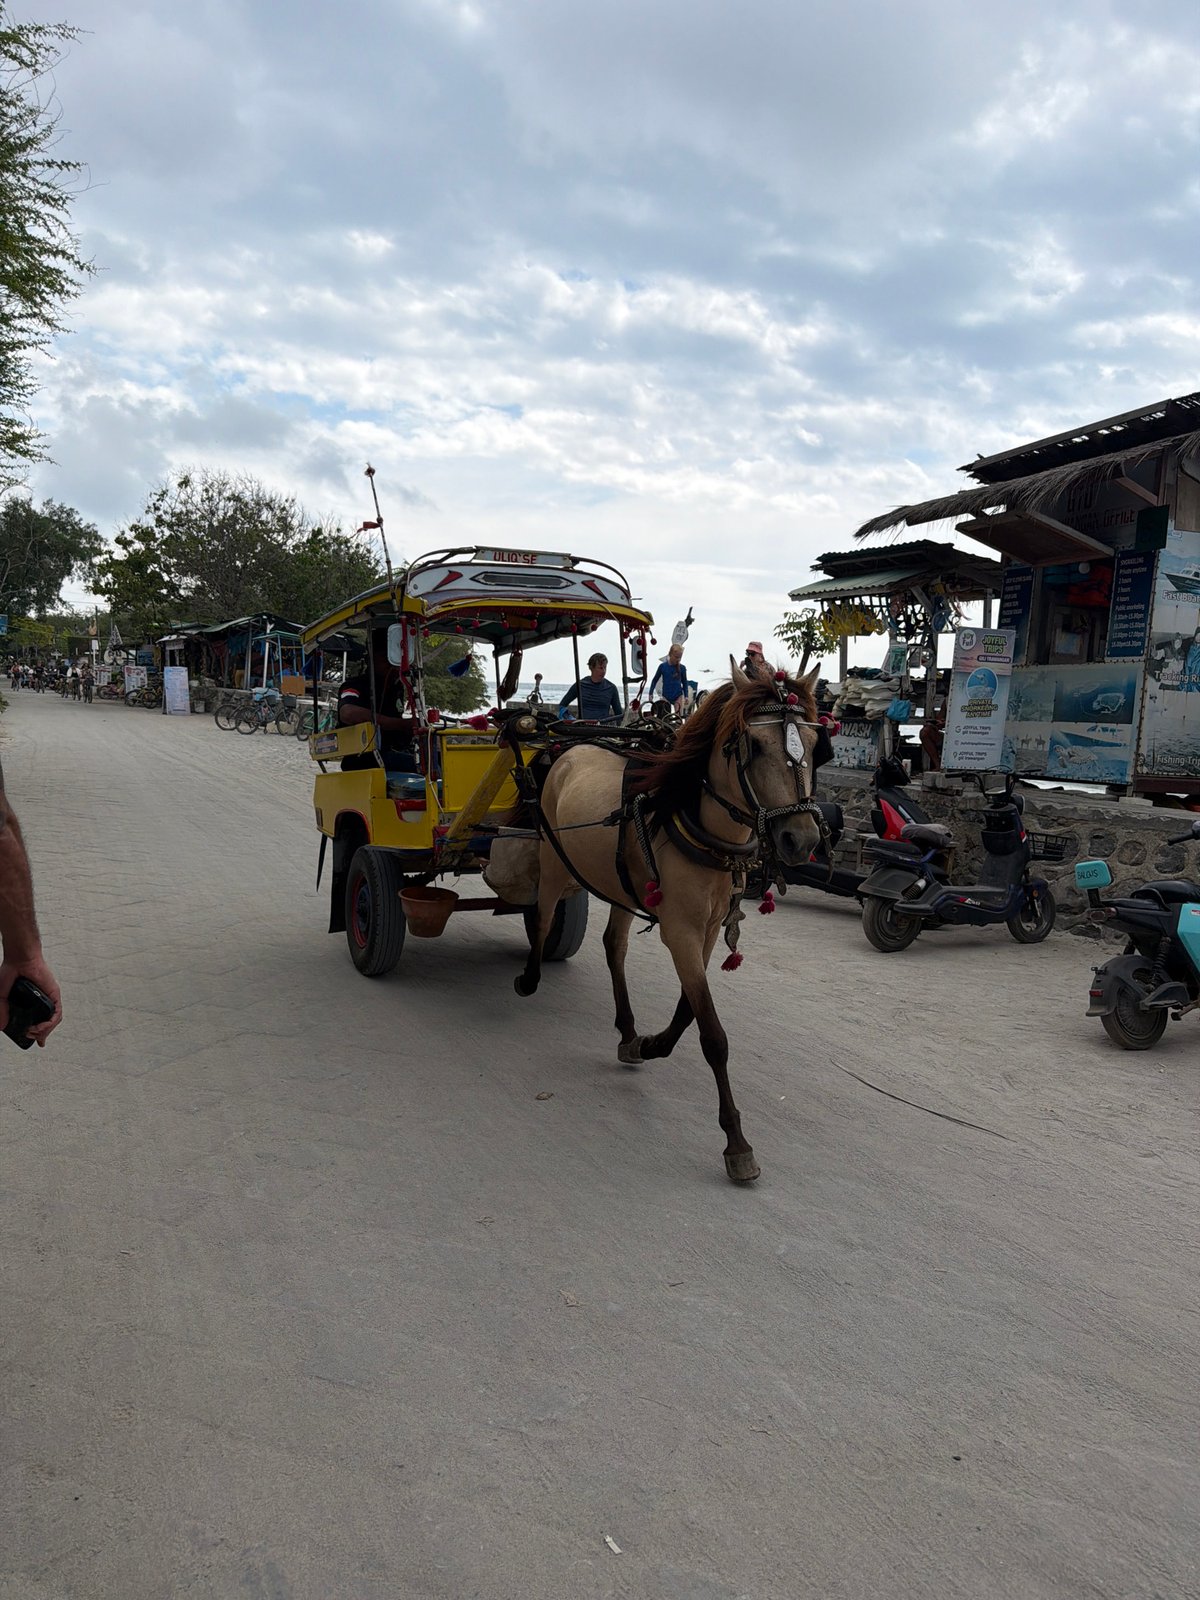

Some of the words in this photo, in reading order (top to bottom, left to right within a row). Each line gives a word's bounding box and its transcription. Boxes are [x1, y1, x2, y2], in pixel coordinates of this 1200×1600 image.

[1103, 509, 1135, 528] OFFICE
[1162, 590, 1180, 601] Fast
[982, 634, 1007, 646] JOYFUL
[984, 644, 1004, 654] TRIPS
[1154, 670, 1189, 683] Tracking
[1191, 674, 1200, 683] Ri
[967, 698, 992, 706] PRIVATE
[965, 710, 992, 718] ANYTIME
[841, 722, 872, 738] WASH
[1157, 754, 1185, 766] Fishing
